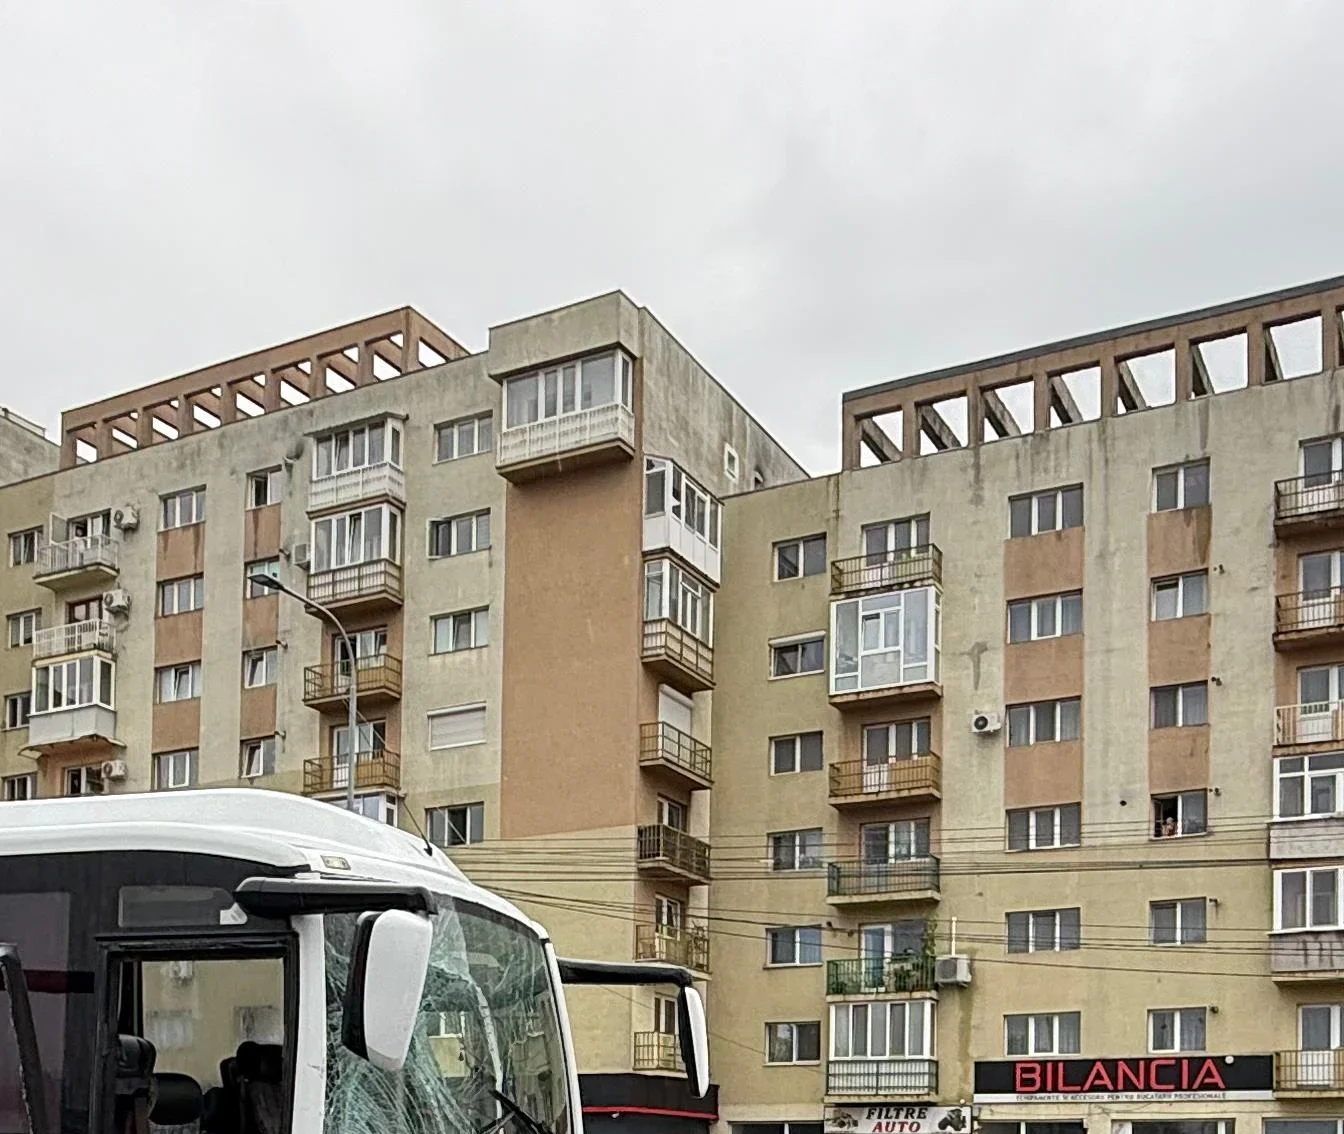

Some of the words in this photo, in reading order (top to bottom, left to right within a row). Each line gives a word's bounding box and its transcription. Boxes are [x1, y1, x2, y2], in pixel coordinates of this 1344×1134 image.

[1015, 1058, 1226, 1092] BILANCIA
[865, 1107, 928, 1120] FILTRE
[872, 1121, 921, 1133] AUTO
